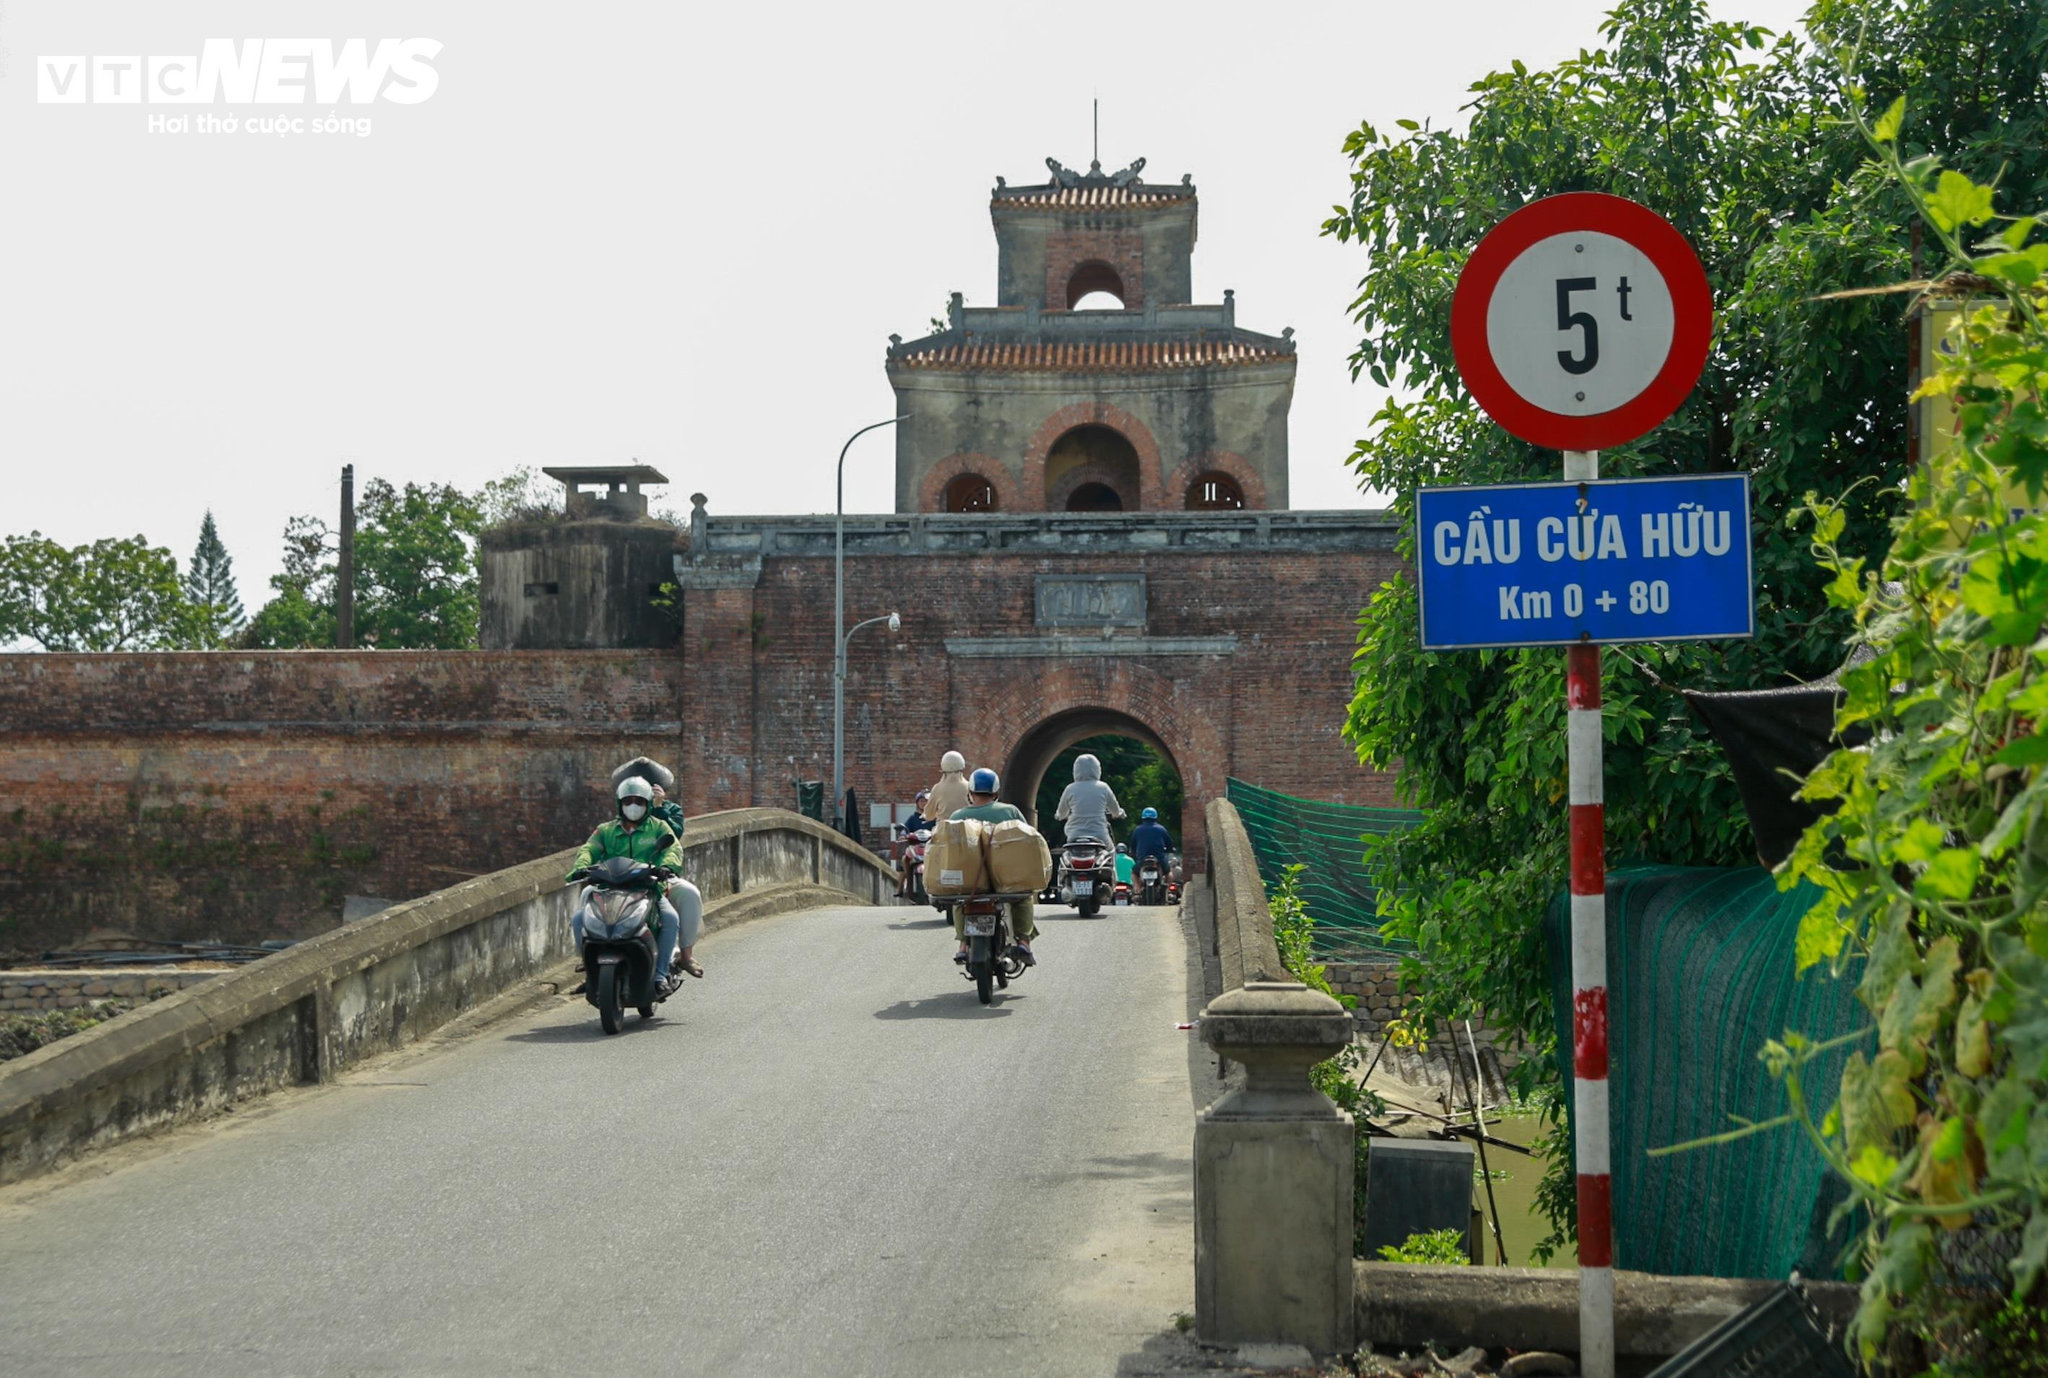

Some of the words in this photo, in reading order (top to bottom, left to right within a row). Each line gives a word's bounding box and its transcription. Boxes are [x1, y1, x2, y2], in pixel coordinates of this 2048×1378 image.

[1434, 505, 1521, 566] CẦU
[1537, 498, 1627, 562] CỬA
[1641, 502, 1731, 558] HỮU
[1499, 586, 1552, 620] Km
[1563, 583, 1583, 618] 0
[1595, 590, 1617, 612] +
[1629, 580, 1669, 615] 80
